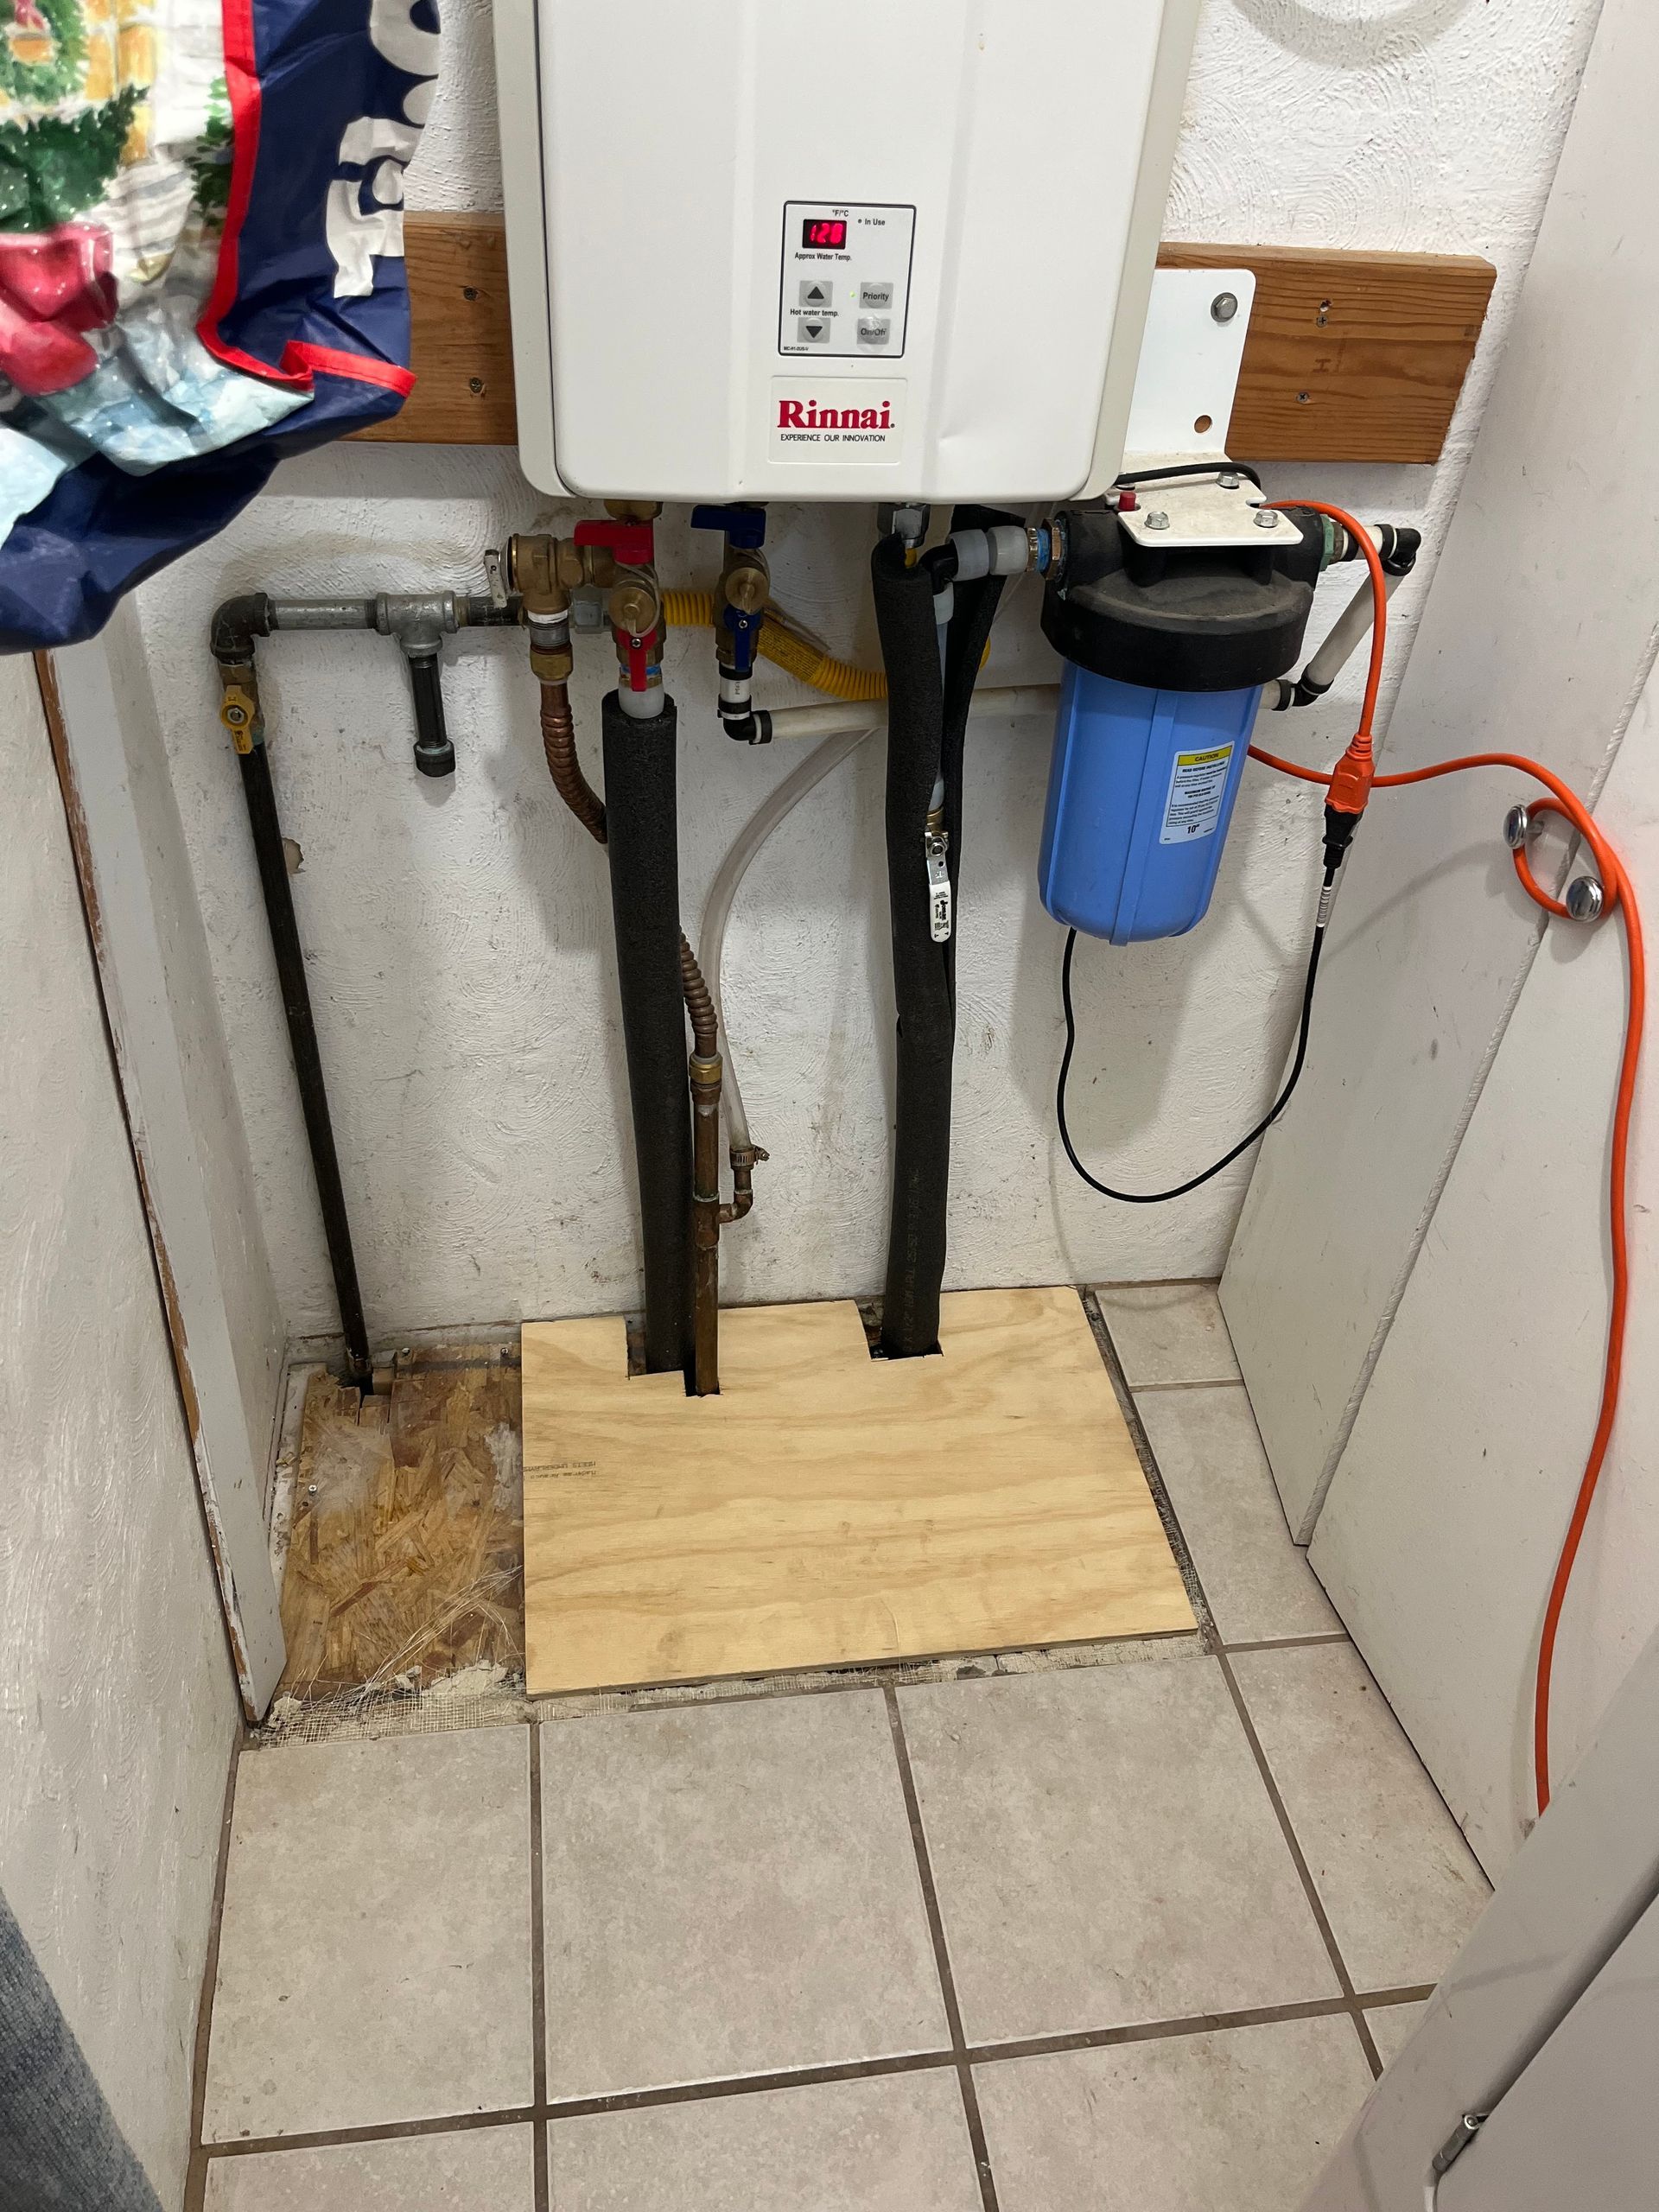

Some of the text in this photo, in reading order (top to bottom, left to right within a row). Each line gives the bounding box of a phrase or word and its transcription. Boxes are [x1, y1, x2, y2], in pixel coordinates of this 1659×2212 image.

[863, 291, 889, 302] Priority
[777, 399, 891, 429] Rinnai
[1194, 753, 1219, 761] CAUTION
